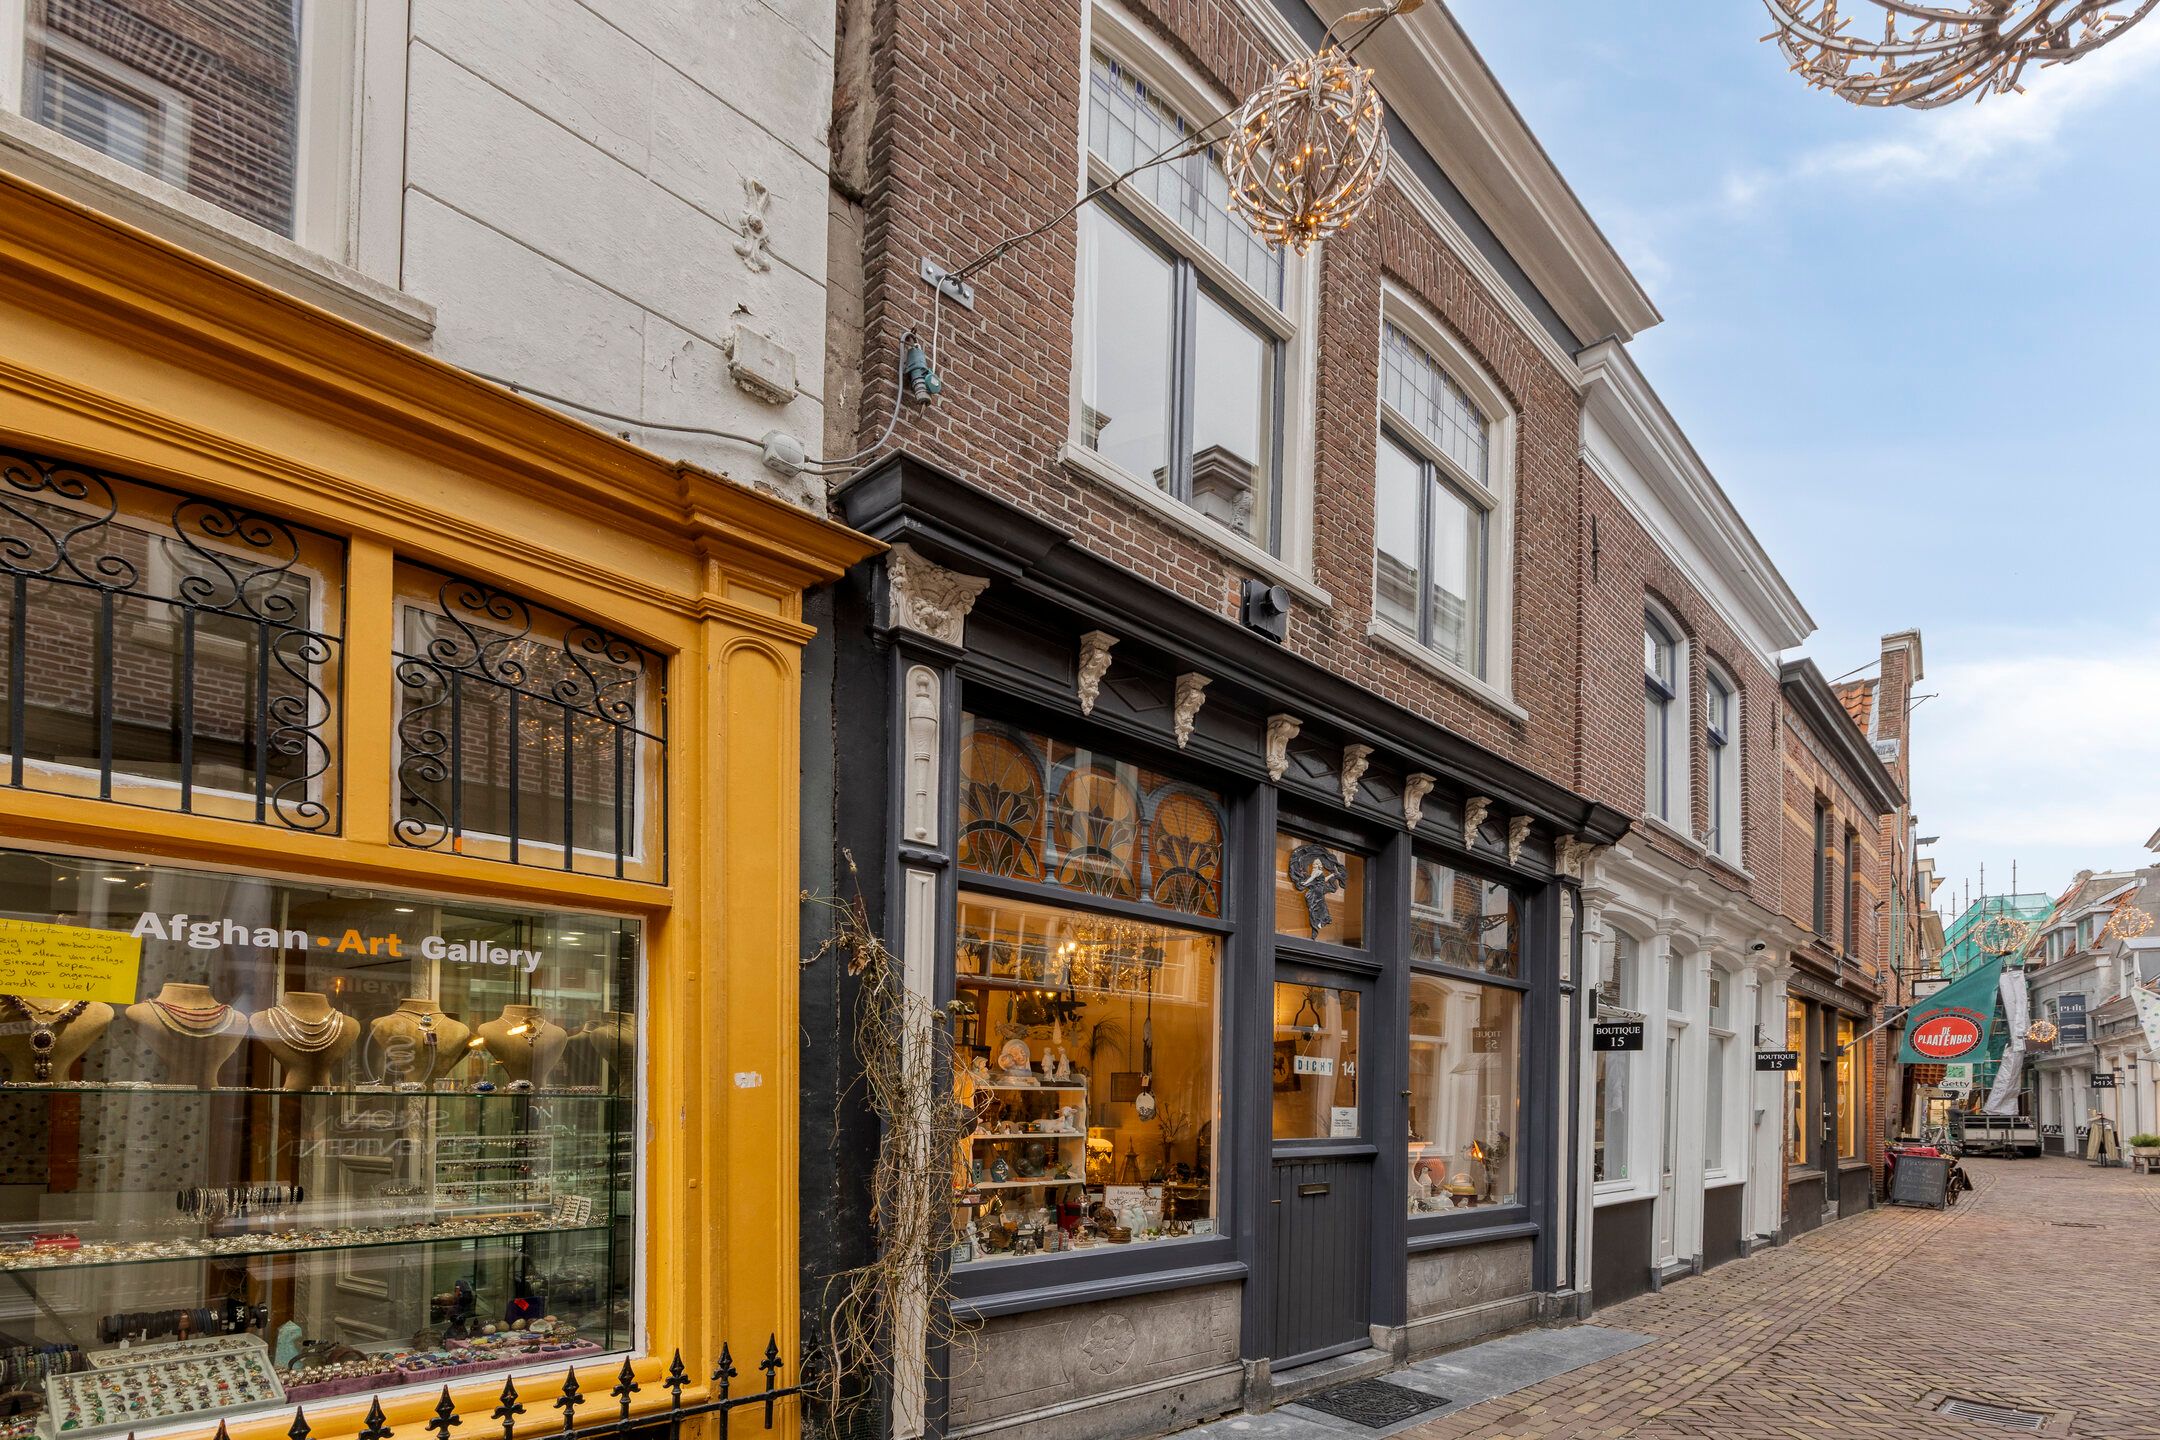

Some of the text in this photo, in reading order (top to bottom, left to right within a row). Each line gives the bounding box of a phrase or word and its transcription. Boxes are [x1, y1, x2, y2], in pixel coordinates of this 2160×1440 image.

[0, 938, 19, 948] zig
[130, 911, 543, 973] Afghan Art Gallery
[1596, 1026, 1641, 1035] BOUTIQUE
[1941, 1026, 1952, 1035] DE
[1611, 1036, 1625, 1047] 15
[1917, 1034, 1973, 1047] PLAATENBAS
[1297, 1059, 1332, 1073] DICHT
[1341, 1061, 1355, 1076] 14
